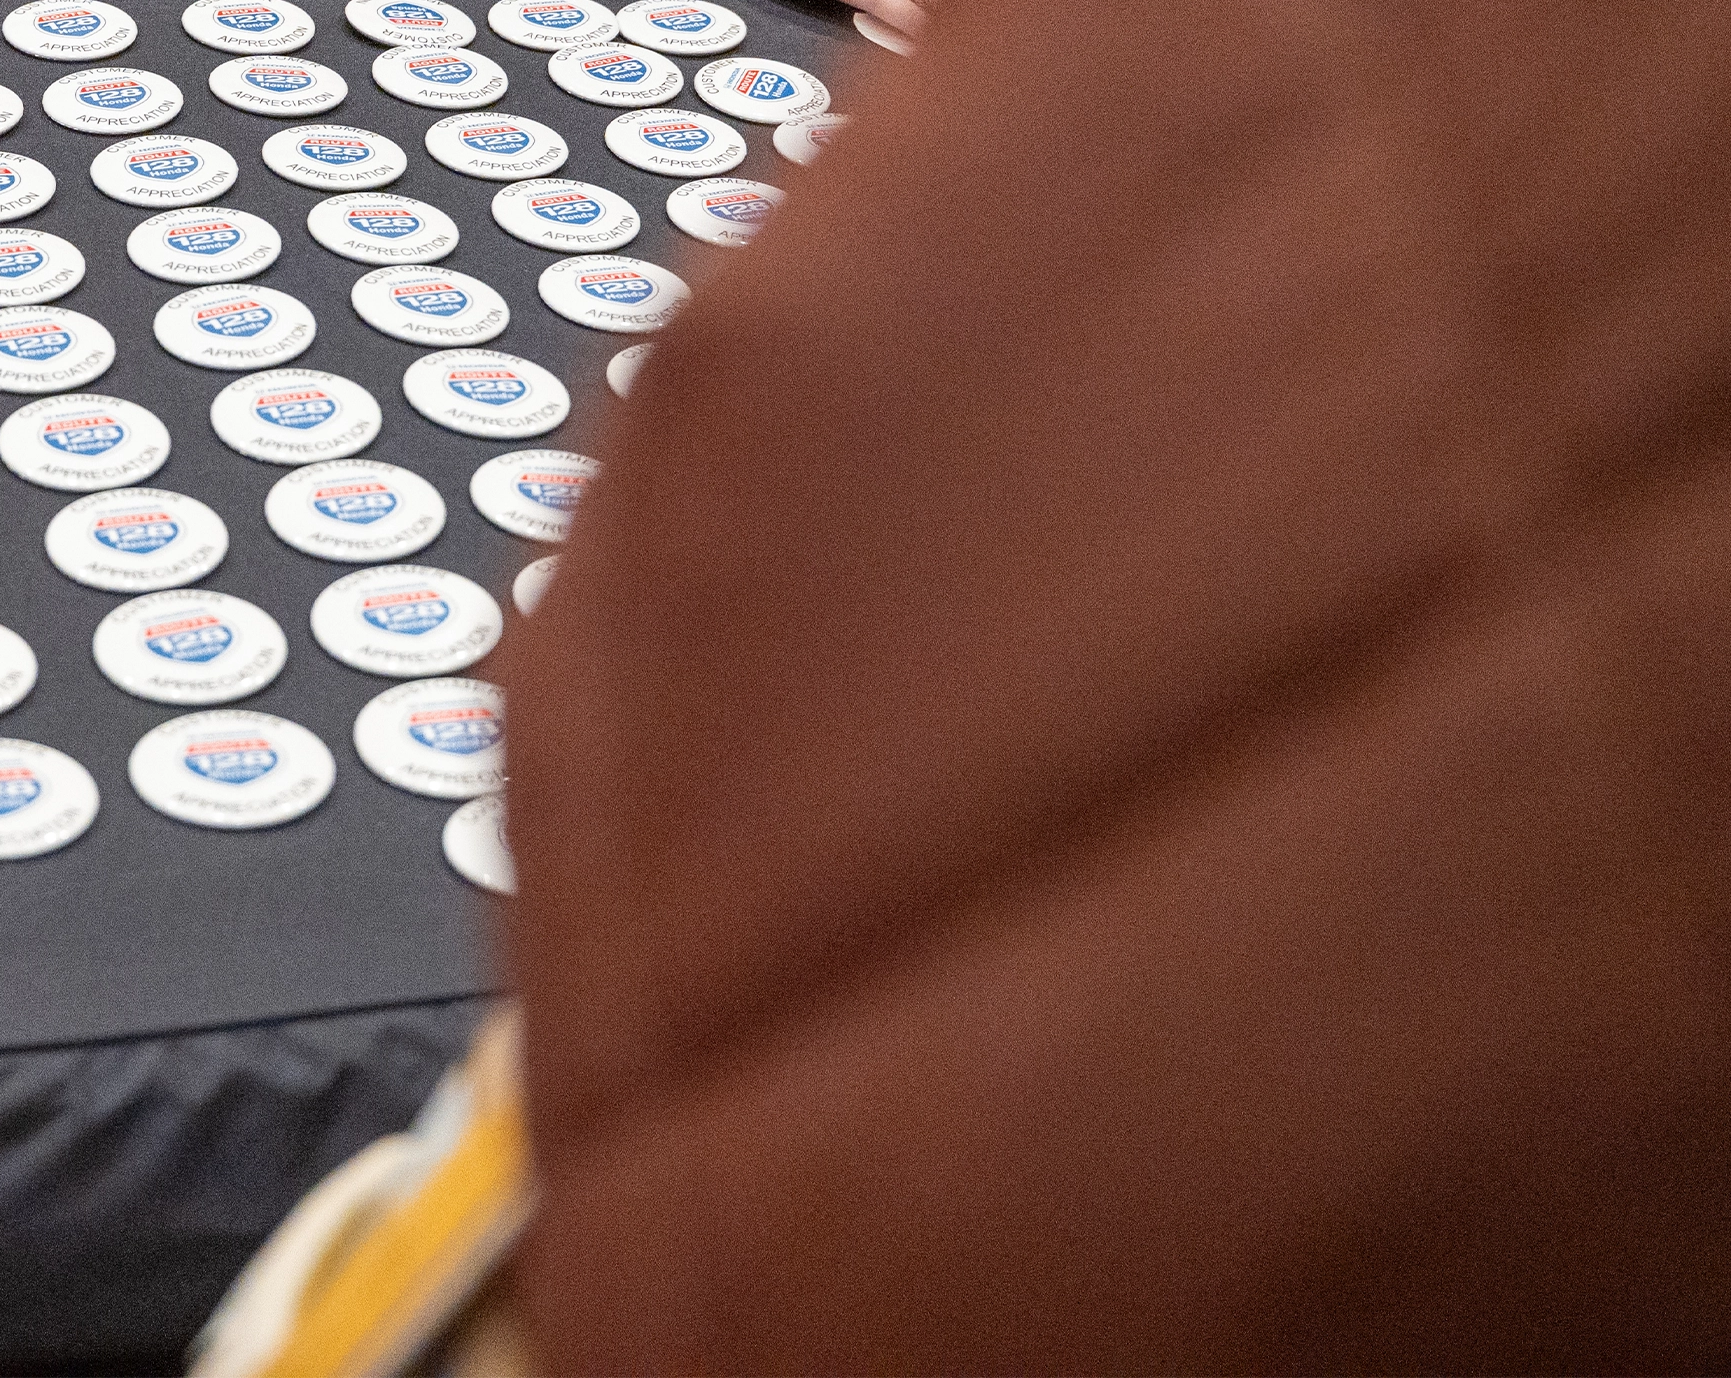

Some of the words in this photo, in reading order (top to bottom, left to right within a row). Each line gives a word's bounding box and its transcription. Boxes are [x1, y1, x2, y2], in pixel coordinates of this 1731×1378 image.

[41, 11, 87, 20] ROUTE
[219, 14, 277, 24] 128
[385, 10, 441, 20] 128
[525, 11, 582, 21] 128
[653, 14, 709, 26] 128
[40, 16, 98, 30] 128
[56, 25, 95, 34] Honda
[42, 27, 132, 52] APPRECIATION
[219, 26, 310, 47] APPRECIATION
[235, 55, 321, 67] CUSTOMER
[60, 67, 146, 84] CUSTOMER
[412, 64, 470, 76] 128
[592, 62, 643, 76] 128
[85, 81, 134, 91] ROUTE
[249, 74, 307, 84] 128
[754, 73, 778, 97] 128
[82, 88, 143, 101] 128
[97, 97, 138, 106] Honda
[231, 91, 335, 107] APPRECIATION
[77, 99, 176, 125] APPRECIATION
[620, 109, 701, 124] CUSTOMER
[440, 112, 521, 128] CUSTOMER
[289, 125, 379, 138] CUSTOMER
[466, 127, 515, 135] ROUTE
[646, 124, 694, 132] ROUTE
[109, 135, 197, 153] CUSTOMER
[466, 133, 527, 146] 128
[646, 131, 707, 143] 128
[134, 150, 186, 161] ROUTE
[304, 145, 365, 156] 128
[650, 144, 743, 168] APPRECIATION
[132, 157, 196, 172] 128
[470, 146, 564, 171] APPRECIATION
[148, 168, 190, 176] Honda
[287, 163, 394, 181] APPRECIATION
[128, 170, 231, 198] APPRECIATION
[506, 179, 588, 197] CUSTOMER
[328, 194, 419, 206] CUSTOMER
[534, 195, 584, 205] ROUTE
[535, 202, 598, 216] 128
[147, 207, 241, 226] CUSTOMER
[351, 218, 416, 227] 128
[555, 212, 597, 221] Honda
[174, 224, 227, 234] ROUTE
[545, 215, 637, 243] APPRECIATION
[170, 231, 237, 246] 128
[346, 235, 452, 256] APPRECIATION
[187, 242, 231, 251] Honda
[164, 245, 273, 274] APPRECIATION
[583, 280, 651, 294] 128
[398, 293, 464, 306] 128
[200, 309, 270, 330] 128
[451, 381, 523, 392] 128
[259, 401, 333, 418] 128
[46, 427, 121, 445] 128
[317, 495, 394, 512] 128
[97, 524, 175, 542] 128
[365, 602, 447, 623] 128
[148, 627, 231, 652] 128
